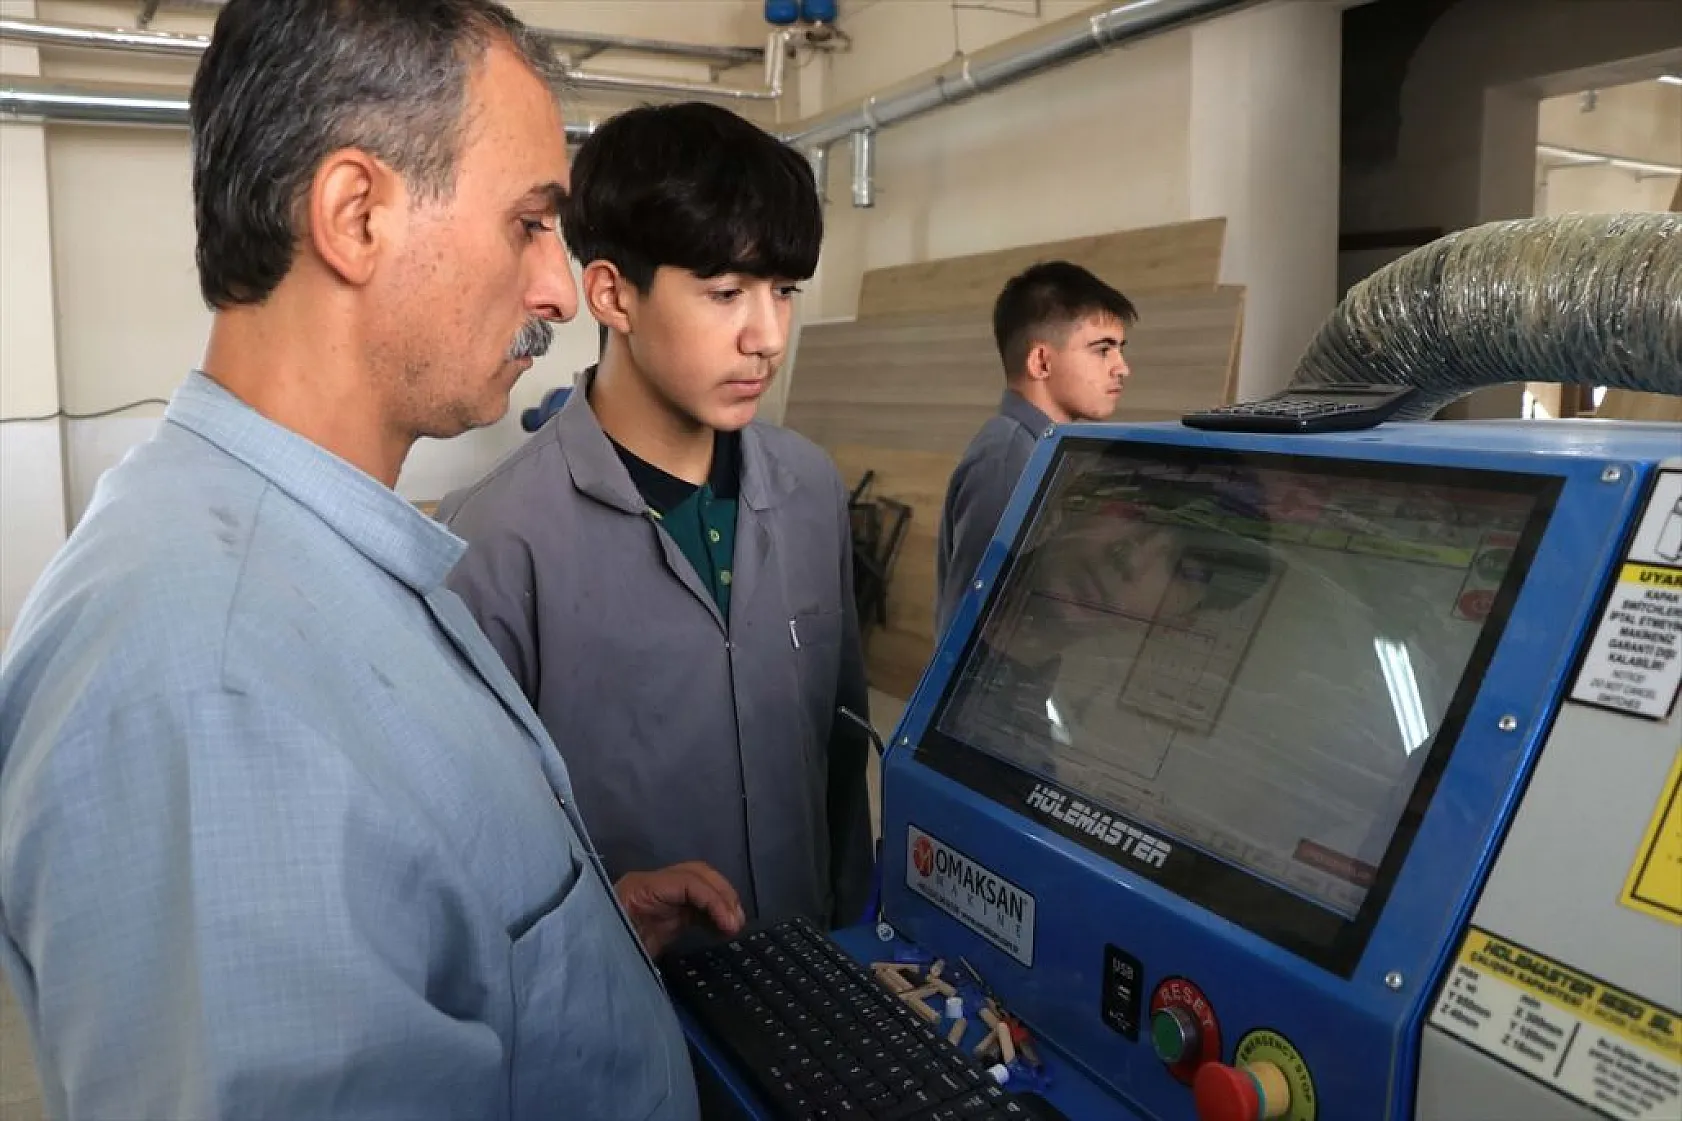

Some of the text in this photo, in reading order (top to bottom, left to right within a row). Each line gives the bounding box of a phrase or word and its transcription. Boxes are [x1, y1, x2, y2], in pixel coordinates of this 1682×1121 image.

[1025, 783, 1173, 869] HOLEMASTER
[935, 849, 1023, 924] OMAKSAN
[1111, 956, 1135, 980] USB
[1160, 983, 1214, 1028] RESET
